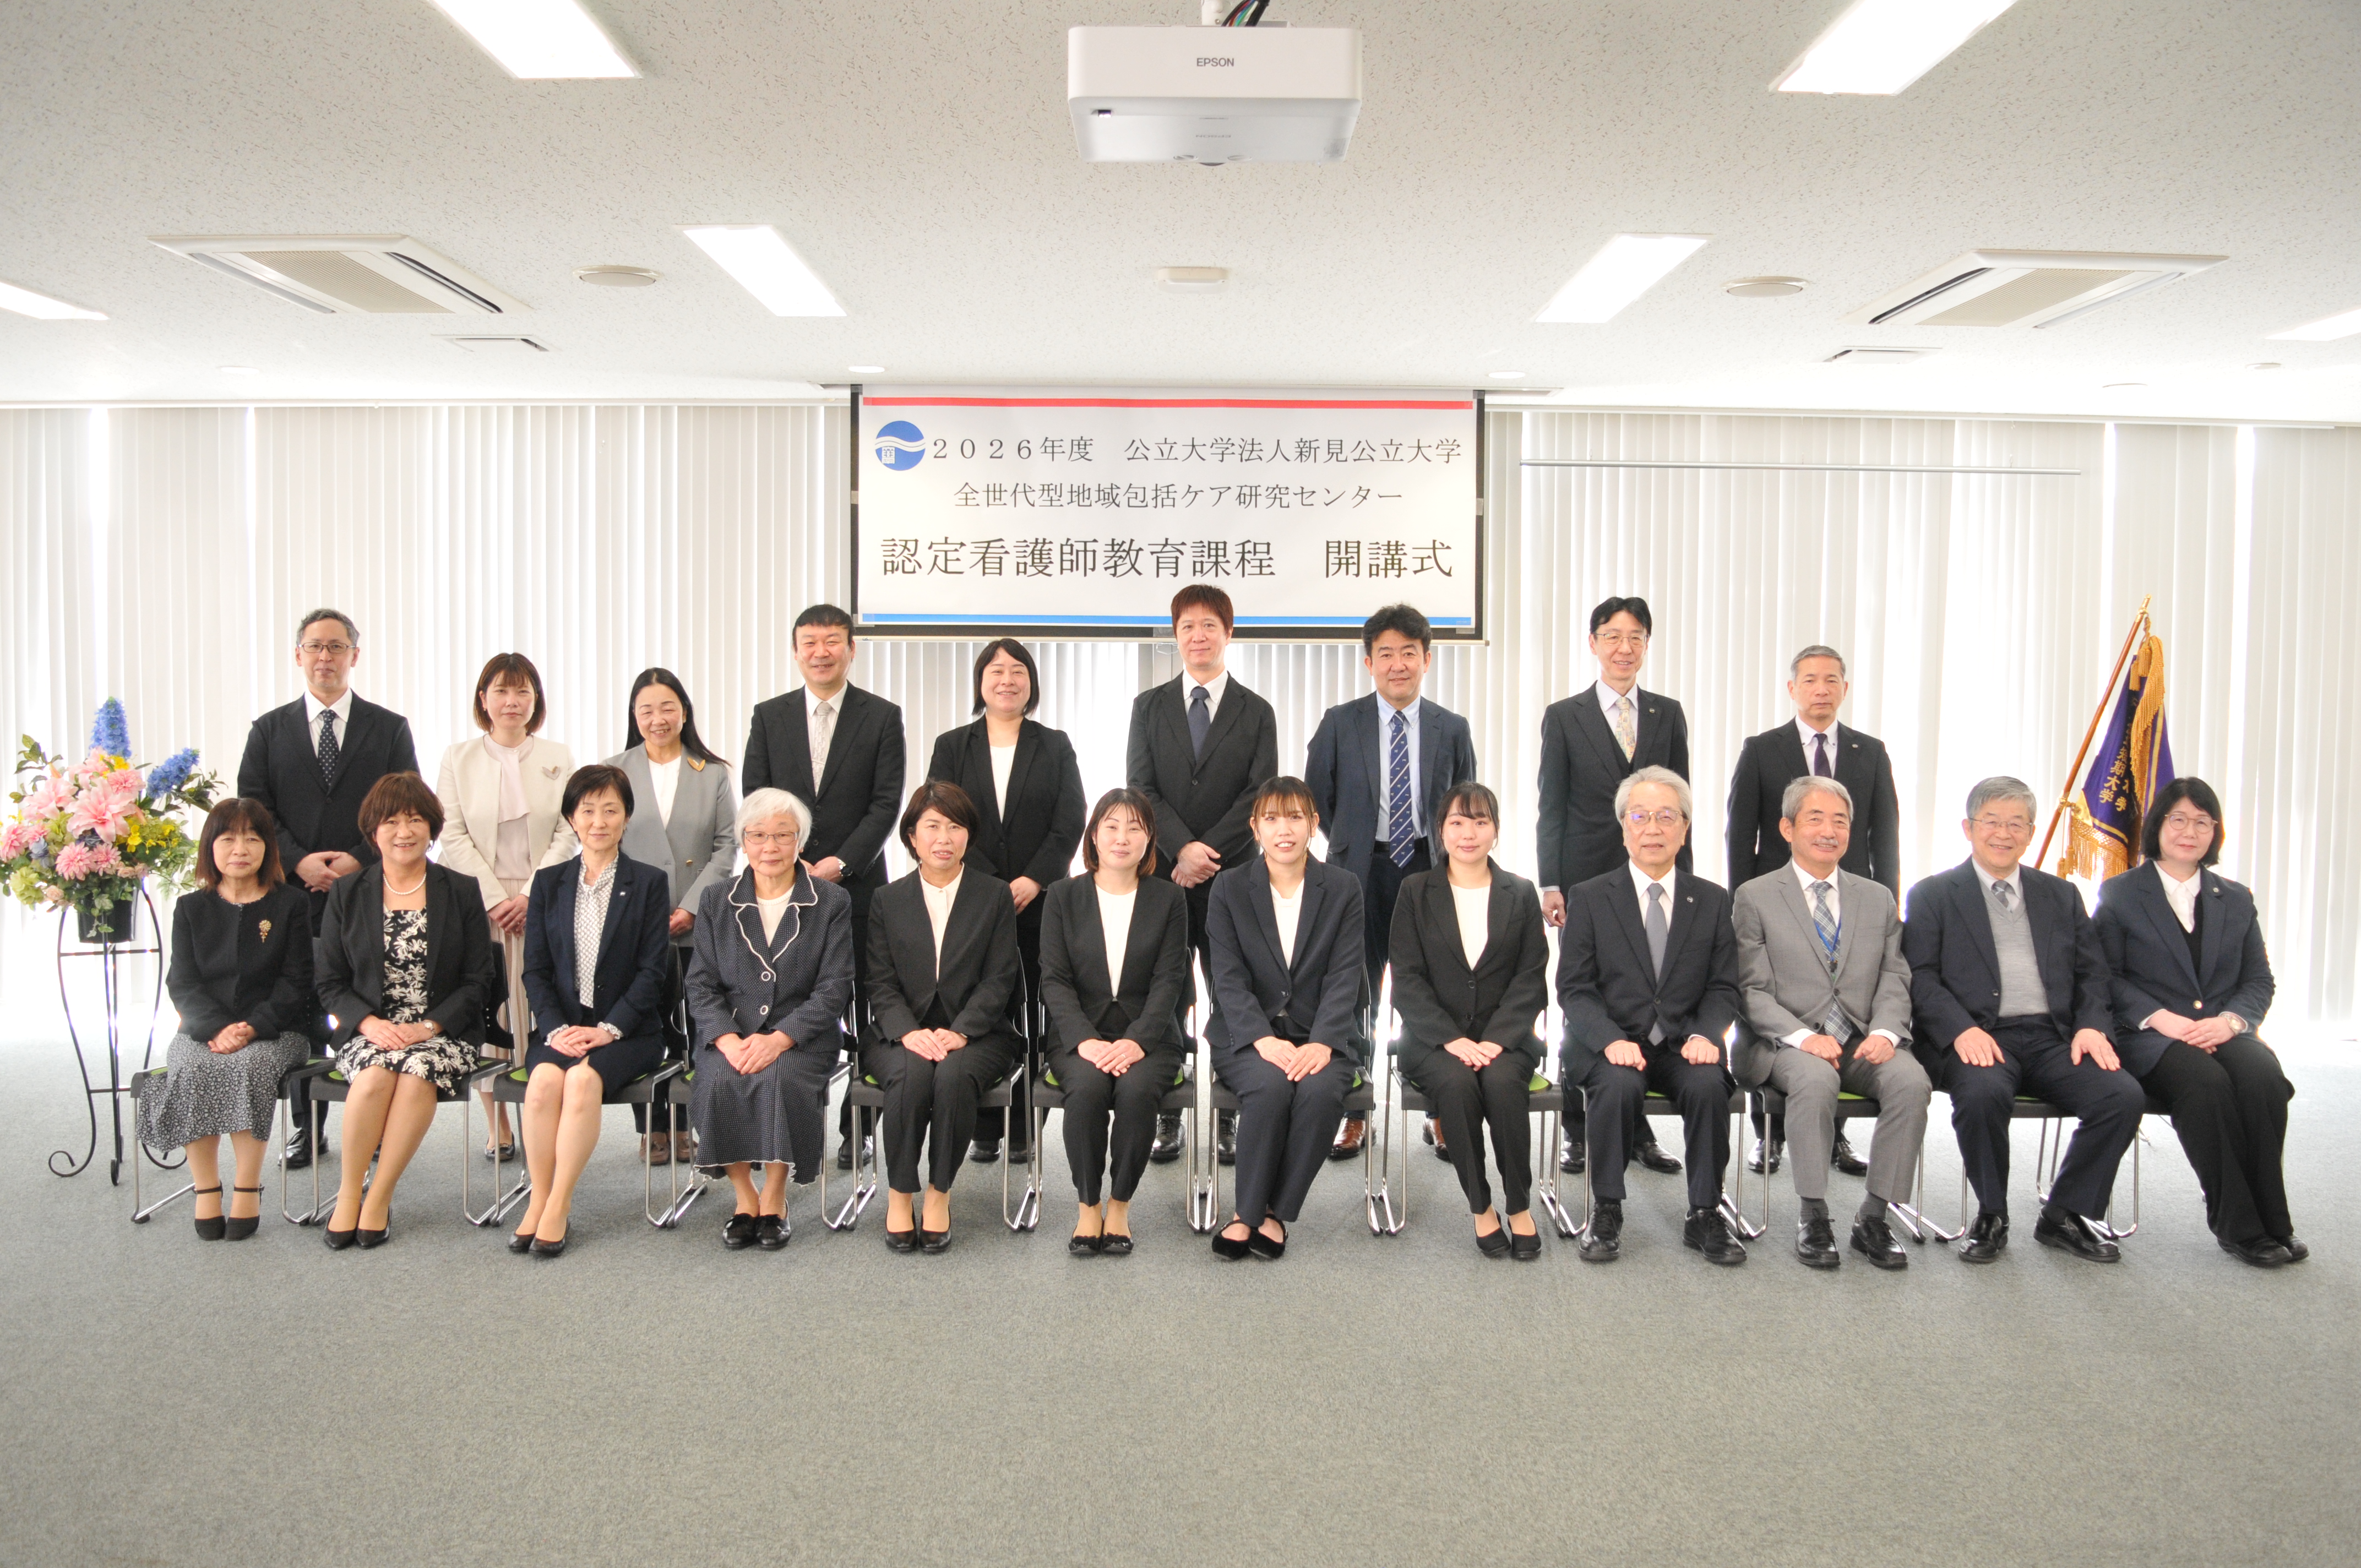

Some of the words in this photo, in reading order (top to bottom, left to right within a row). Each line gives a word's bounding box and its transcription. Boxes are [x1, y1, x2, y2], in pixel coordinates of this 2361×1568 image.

[1196, 57, 1234, 67] EPSON
[933, 435, 1094, 462] 2026年度
[1124, 437, 1461, 464] 公立大学法人新見公立大学
[954, 482, 1403, 509] 全世代型地域包括ケア研究センター
[881, 536, 1276, 579] 認定看護師教育課程
[1325, 539, 1452, 579] 開講式
